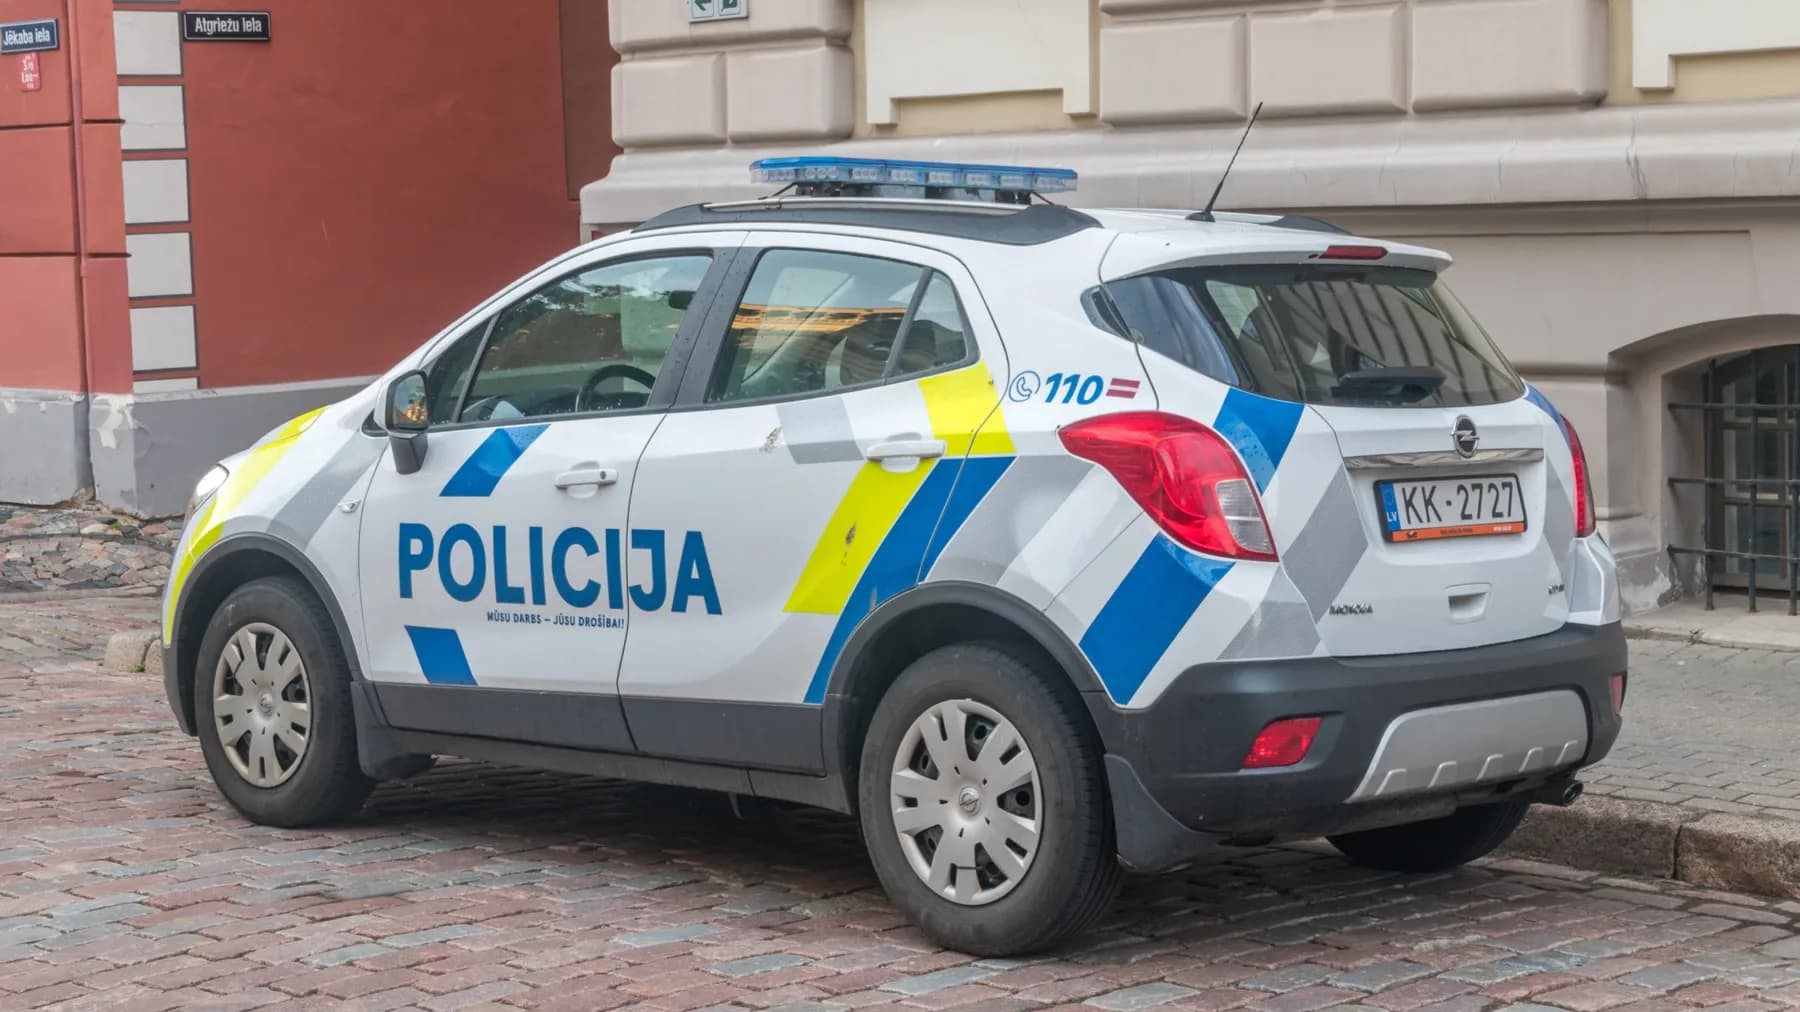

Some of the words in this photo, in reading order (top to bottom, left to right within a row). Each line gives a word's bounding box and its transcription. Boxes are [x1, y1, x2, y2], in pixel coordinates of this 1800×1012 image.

[195, 16, 240, 35] Atgriežu
[34, 27, 51, 43] iela
[1045, 372, 1104, 405] 110
[1386, 511, 1398, 523] LV
[399, 522, 723, 616] POLICIJA
[487, 610, 511, 623] MŪSU
[513, 612, 542, 625] DARBS
[553, 613, 576, 626] JŪSU
